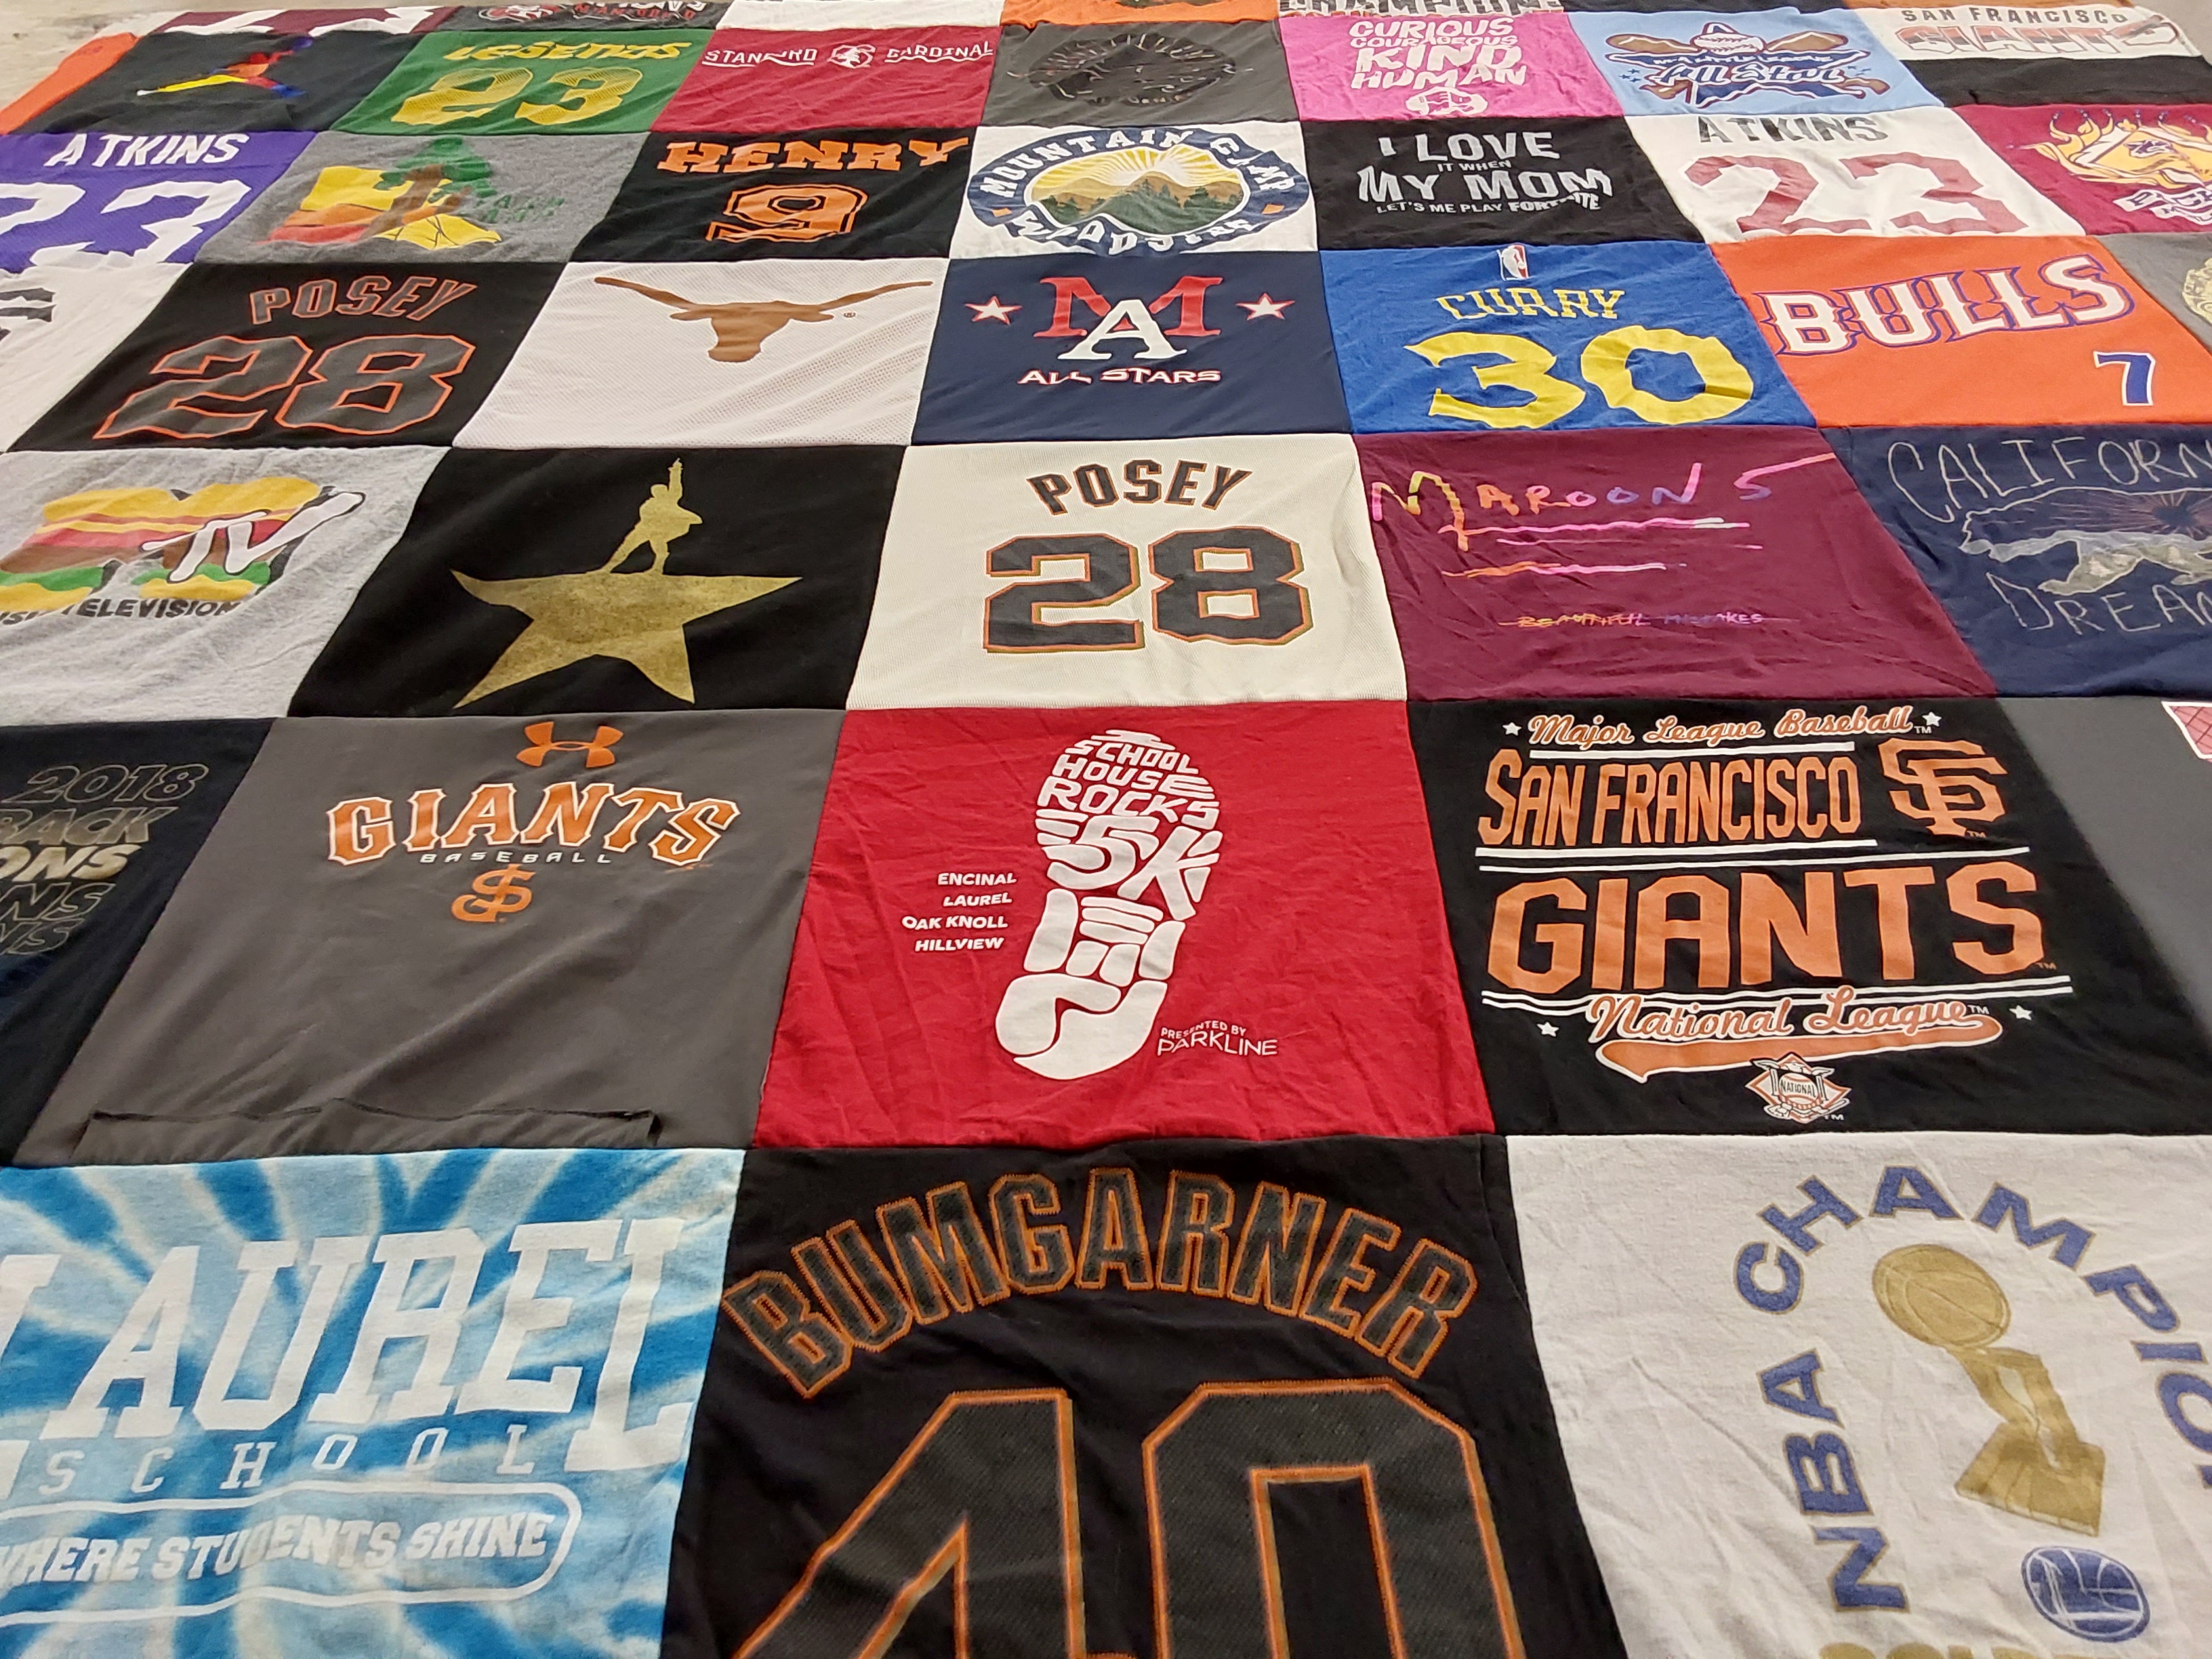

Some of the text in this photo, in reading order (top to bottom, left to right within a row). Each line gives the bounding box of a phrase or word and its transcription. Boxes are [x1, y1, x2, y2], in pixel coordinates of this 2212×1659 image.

[1349, 18, 1514, 39] CURIOUS
[1903, 7, 2129, 24] SAN FRANCISCO
[705, 48, 818, 64] STANRD
[1350, 35, 1518, 47] COURAGEOUS
[1355, 45, 1522, 73] KIND
[1351, 64, 1526, 89] HUMAN
[1378, 131, 1560, 163] I LOVE
[1698, 116, 1889, 143] ATKINS
[43, 134, 250, 167] ATKINS
[657, 138, 969, 173] HENRY
[980, 129, 1194, 198] MOUNTAIN
[1436, 160, 1512, 172] IT WHEN
[1357, 165, 1612, 202] MY MOM
[1684, 152, 2030, 234] 23
[706, 183, 868, 243] 9
[1376, 201, 1425, 213] LET'S
[1430, 203, 1456, 213] ME
[1460, 203, 1502, 213] PLAY
[249, 274, 478, 325] POSEY
[1435, 287, 1626, 321] CURRY
[1753, 253, 2135, 356] BULLS
[92, 334, 476, 441] 28
[1018, 367, 1221, 385] ALL STARS
[1403, 325, 1755, 430] 30
[2093, 350, 2156, 407] 7
[1026, 459, 1253, 516] POSEY
[983, 525, 1314, 653] 28
[1527, 714, 1635, 750] Major
[1642, 714, 1766, 747] League
[1774, 705, 1914, 739] Baseball
[1065, 739, 1199, 775] SCHOOL
[1, 763, 209, 804] 2018
[1052, 754, 1215, 800] HOUSE
[1037, 775, 1220, 830] ROCKS
[1478, 748, 1861, 846] SAN FRANCISCO
[326, 781, 741, 865] GIANTS
[419, 851, 613, 864] BASEBALL
[1047, 815, 1221, 920] 5K
[937, 872, 1017, 887] ENCINAL
[943, 892, 1013, 907] LAUREL
[902, 916, 1008, 930] OAK KNOLL
[1488, 861, 2044, 995] GIANTS
[915, 937, 1004, 951] HILLVIEW
[1161, 1020, 1246, 1039] PRESENTED BY
[1585, 993, 1795, 1044] National
[1803, 985, 1969, 1037] League
[1157, 1031, 1278, 1057] PARKLINE
[1780, 1079, 1816, 1098] NATIONAL
[721, 1166, 1479, 1398] BUMGARNER
[1734, 1166, 2212, 1490] CHAMPIO
[1757, 1348, 1910, 1613] NBA
[152, 1514, 400, 1580] STUDENTS
[407, 1511, 555, 1561] SHINE
